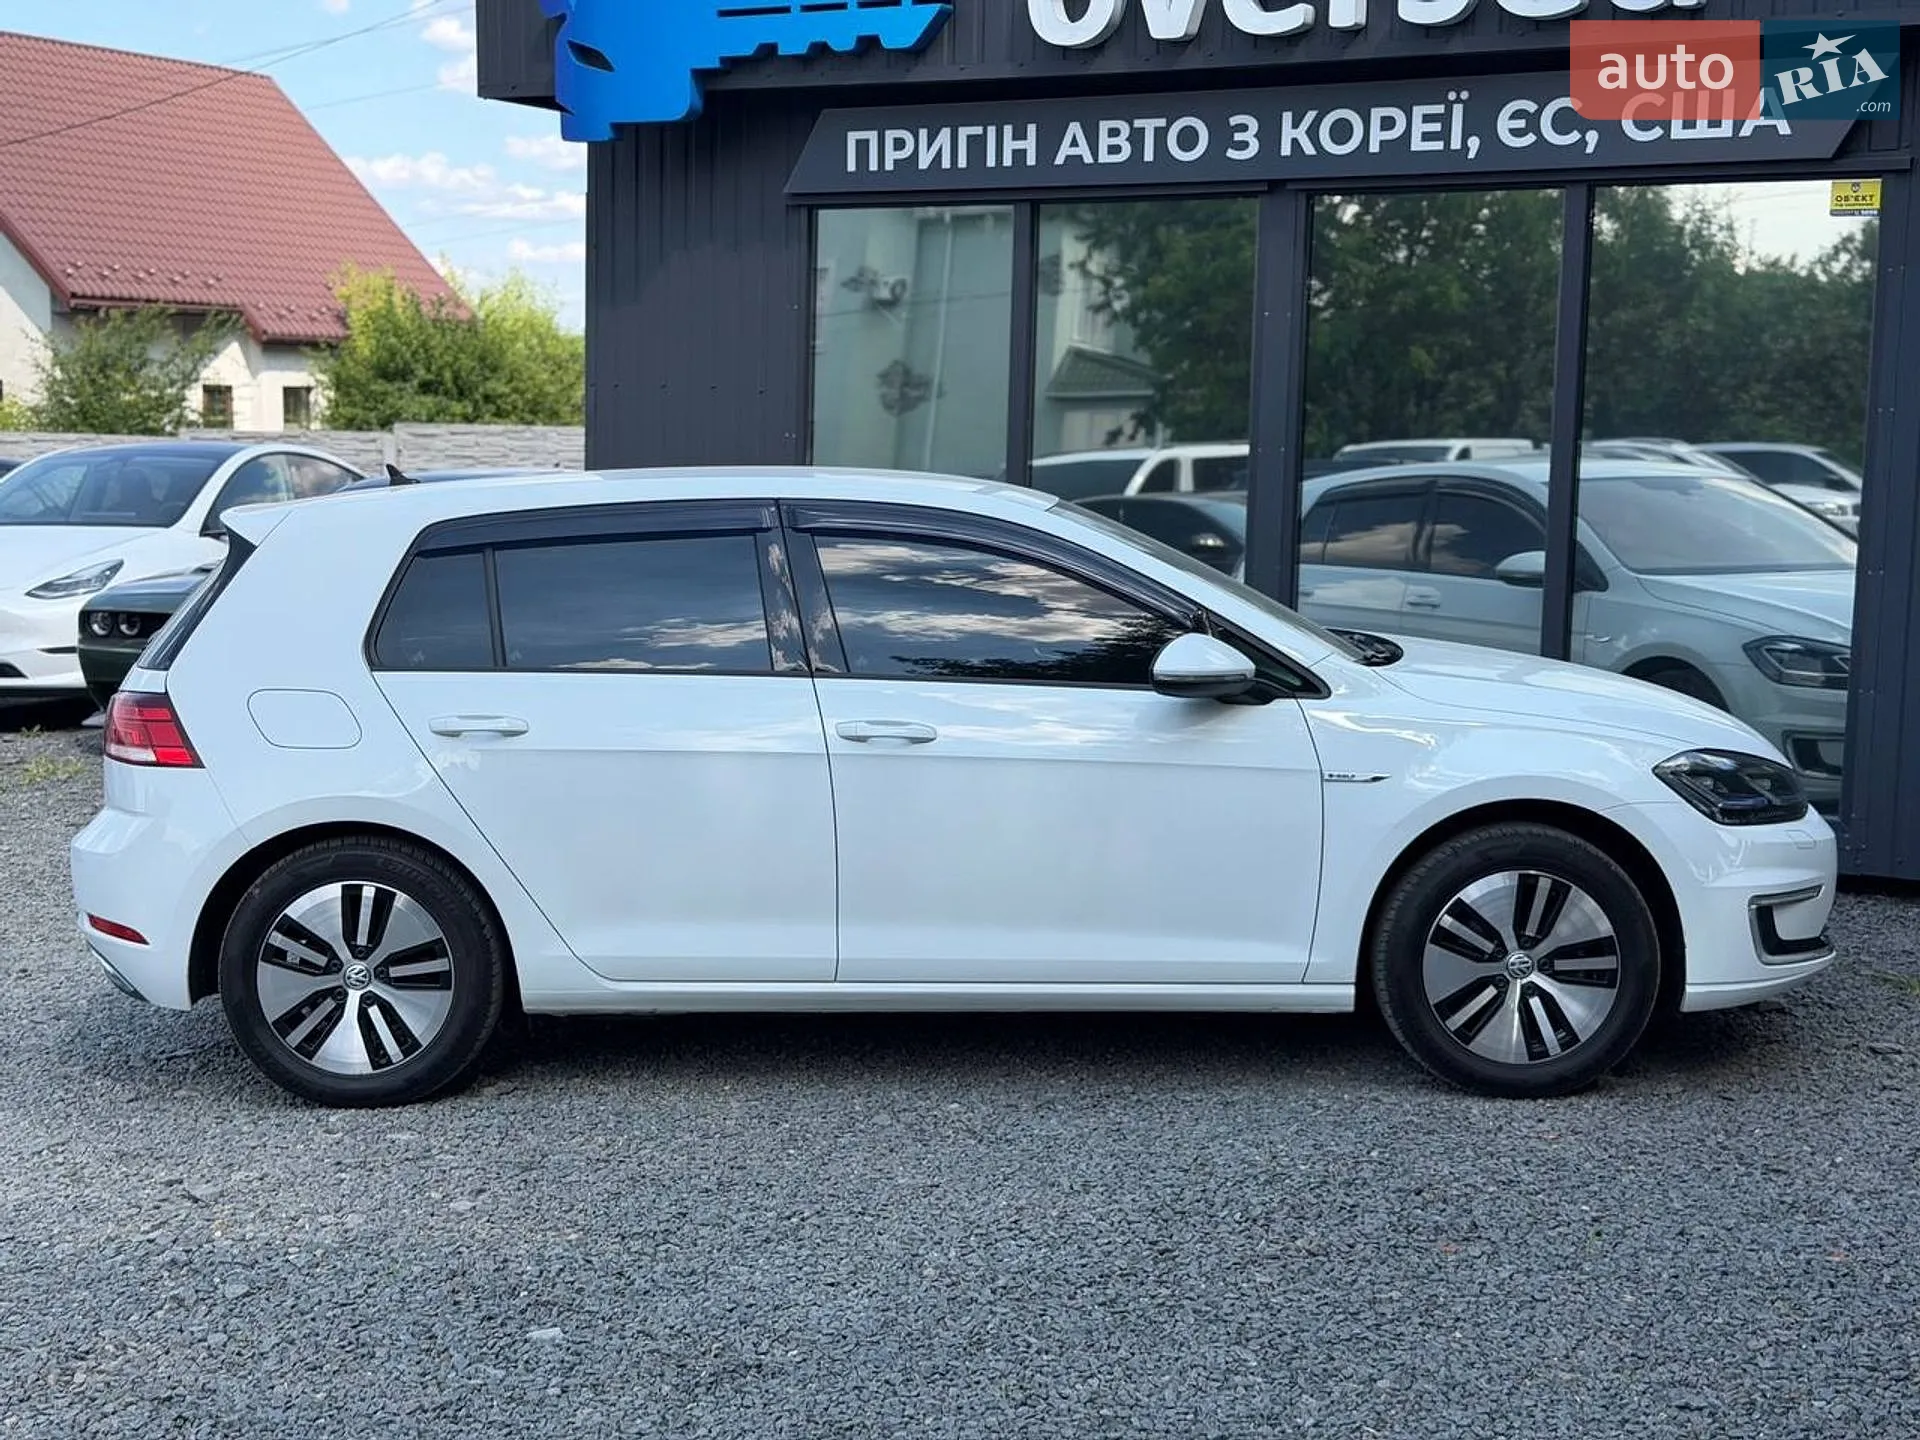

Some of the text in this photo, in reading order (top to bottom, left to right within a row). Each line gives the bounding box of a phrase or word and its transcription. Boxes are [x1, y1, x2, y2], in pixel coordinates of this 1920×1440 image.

[846, 86, 1792, 172] ПРИГІН АВТО З КОРЕЇ, ЄС, США
